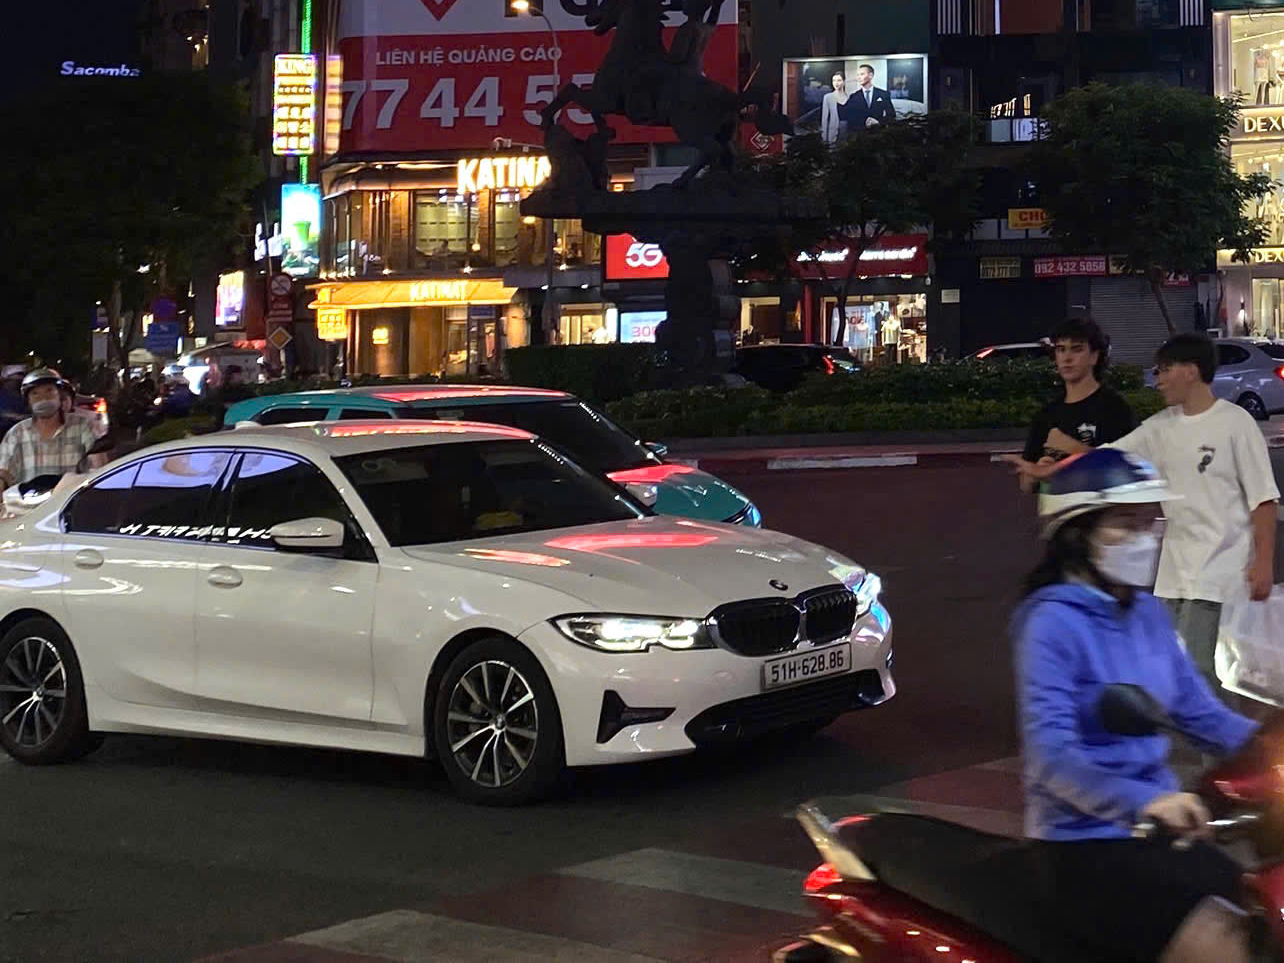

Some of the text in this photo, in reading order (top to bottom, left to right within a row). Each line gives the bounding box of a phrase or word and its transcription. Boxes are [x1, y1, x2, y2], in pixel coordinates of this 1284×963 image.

[375, 43, 562, 67] LIÊN HỆ QUẢNG CÁO
[420, 77, 504, 128] 44
[625, 242, 664, 268] 5G
[771, 650, 844, 683] 51H-628.86
